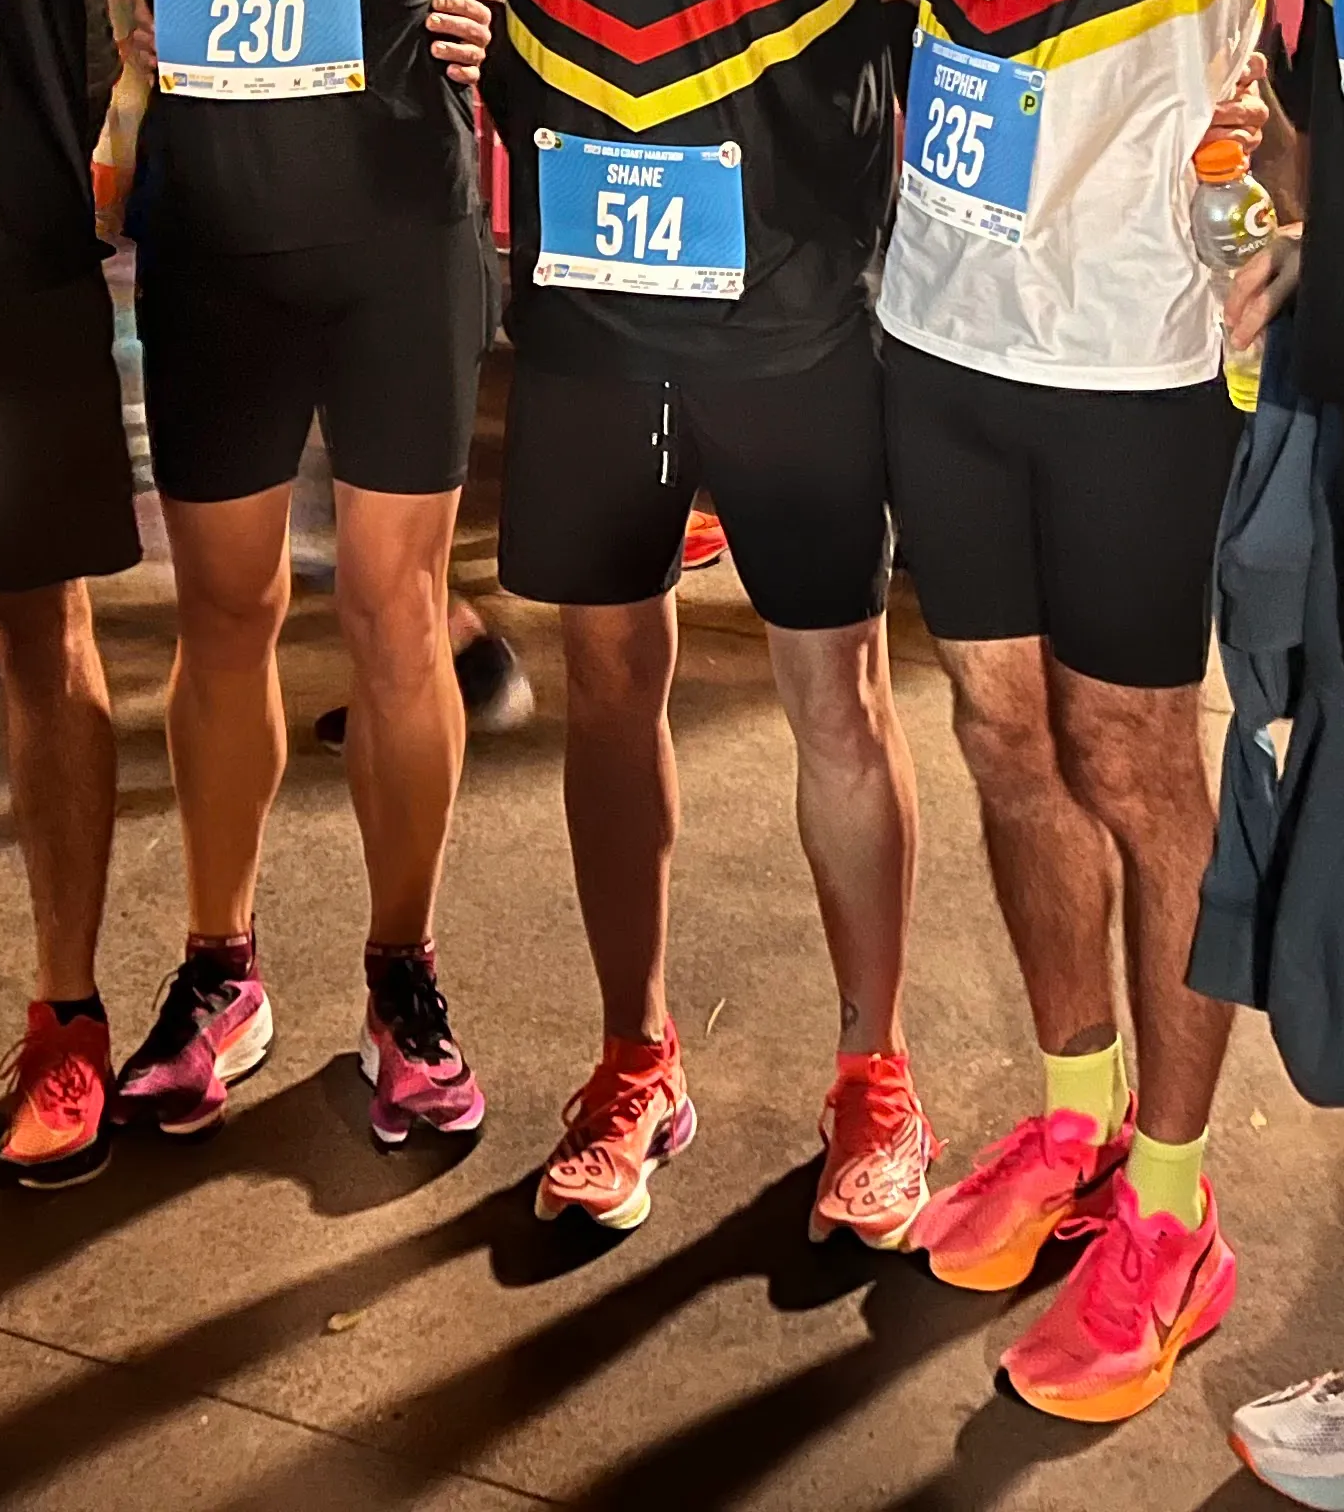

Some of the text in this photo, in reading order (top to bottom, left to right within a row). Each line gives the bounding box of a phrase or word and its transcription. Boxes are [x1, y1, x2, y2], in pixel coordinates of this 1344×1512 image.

[933, 63, 989, 103] STEPHEN
[1023, 93, 1036, 112] P
[920, 96, 994, 189] 235
[606, 163, 665, 188] SHANE
[595, 190, 684, 261] 514
